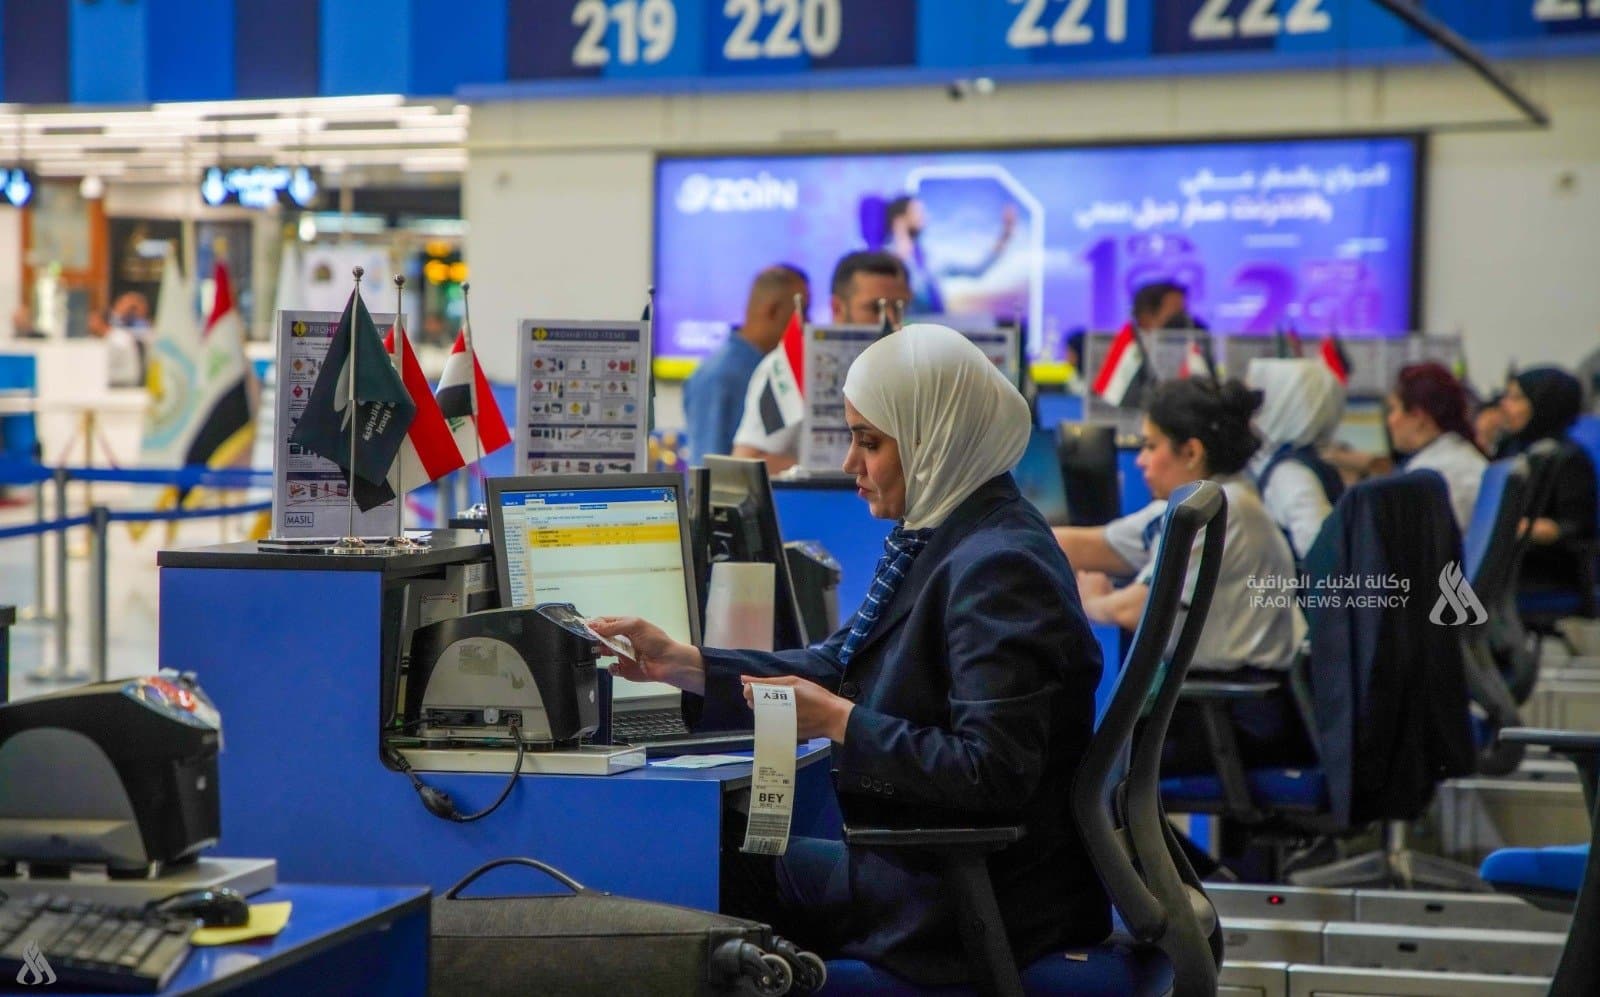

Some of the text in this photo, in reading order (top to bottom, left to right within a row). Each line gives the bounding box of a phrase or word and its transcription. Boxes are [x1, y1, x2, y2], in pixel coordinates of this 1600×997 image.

[570, 0, 677, 67] 219
[722, 0, 842, 60] 220
[1005, 0, 1128, 48] 221
[549, 330, 599, 338] PROHIBITED
[759, 792, 785, 803] BEY
